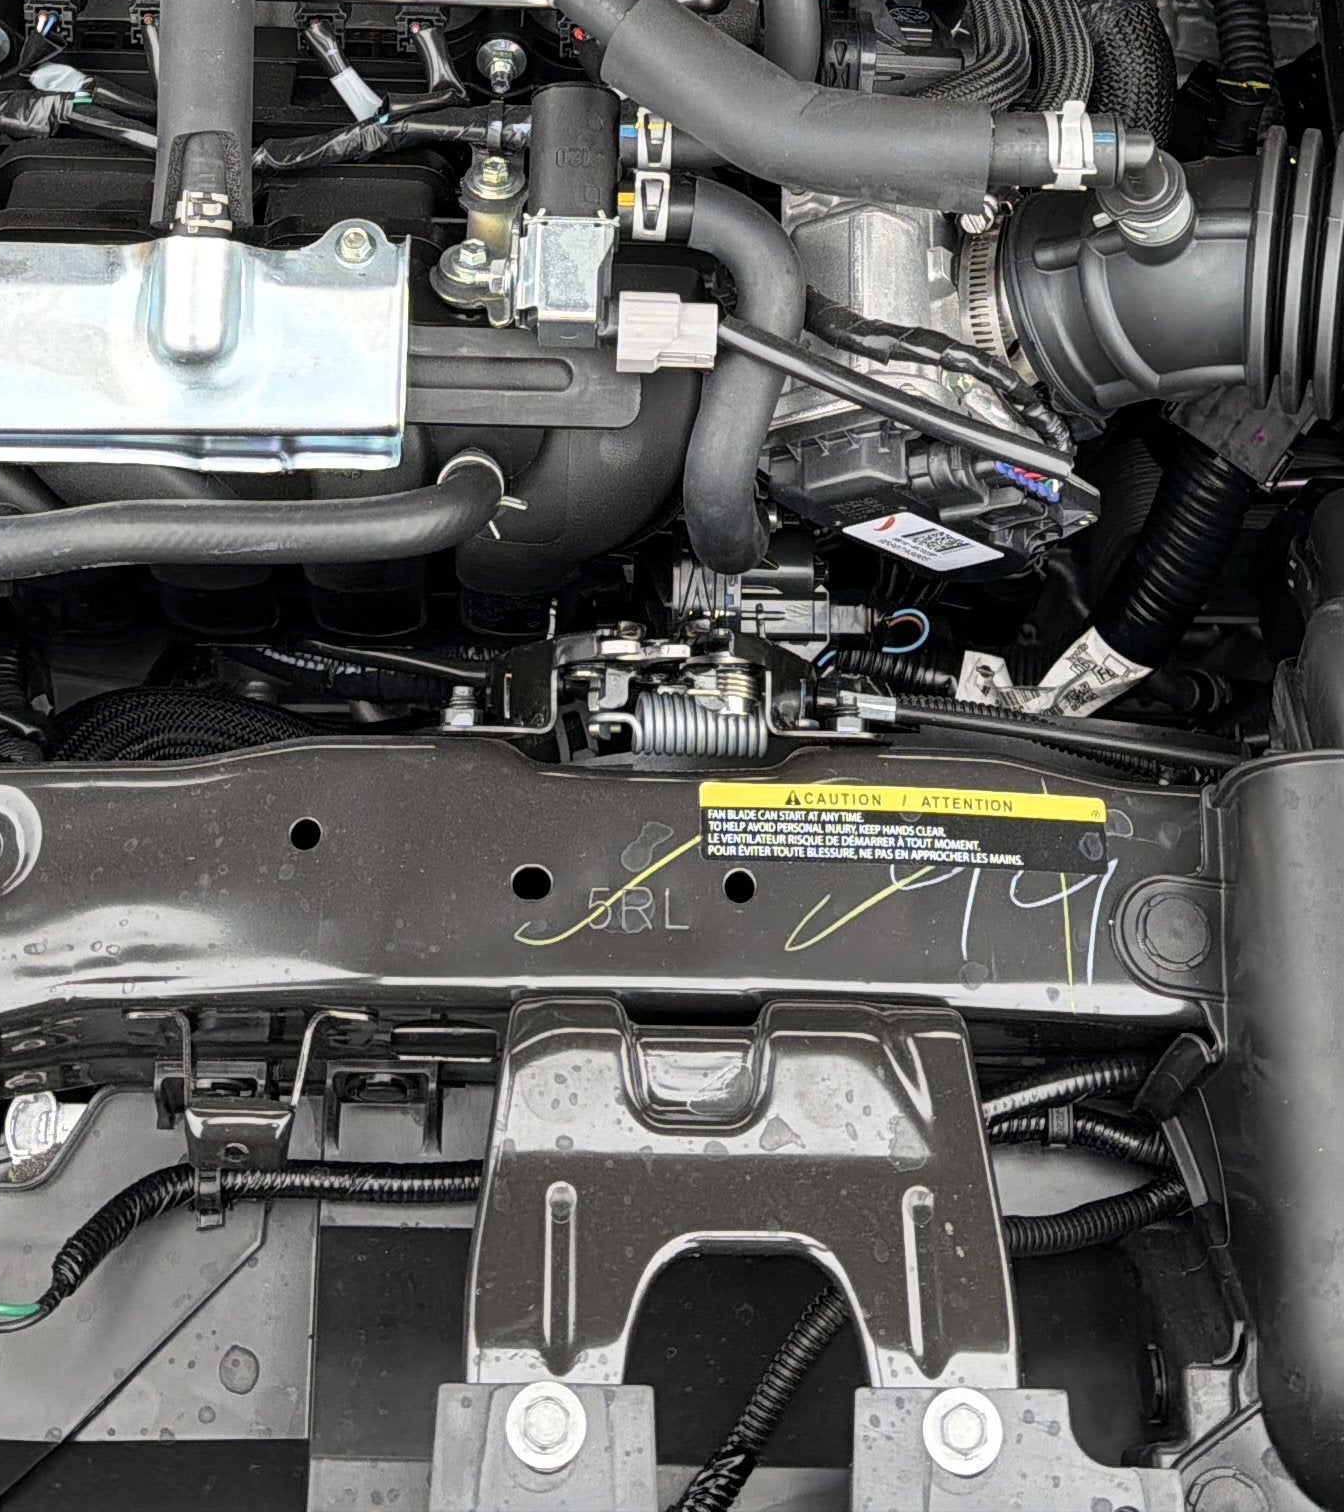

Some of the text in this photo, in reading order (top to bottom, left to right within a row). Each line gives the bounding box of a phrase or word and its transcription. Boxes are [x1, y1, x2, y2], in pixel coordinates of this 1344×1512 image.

[803, 791, 883, 806] CAUTION
[921, 796, 1014, 813] ATTENTION
[707, 809, 727, 820] FAN
[727, 809, 757, 820] BLADE
[757, 810, 778, 821] CAN
[779, 811, 807, 821] START
[807, 811, 819, 821] AT
[708, 821, 947, 838] TO HELP AVOID PERSONAL INJURY, KEEP HANDS CLEAR.
[707, 833, 982, 851] LE VENTILATEUR RISQUE DE DÉMARRER À TOUT MOMENT.
[707, 843, 1025, 866] POUR ÉVITER TOUTE BLESSURE, NE PAS EN APPROCHER LES MAINS.
